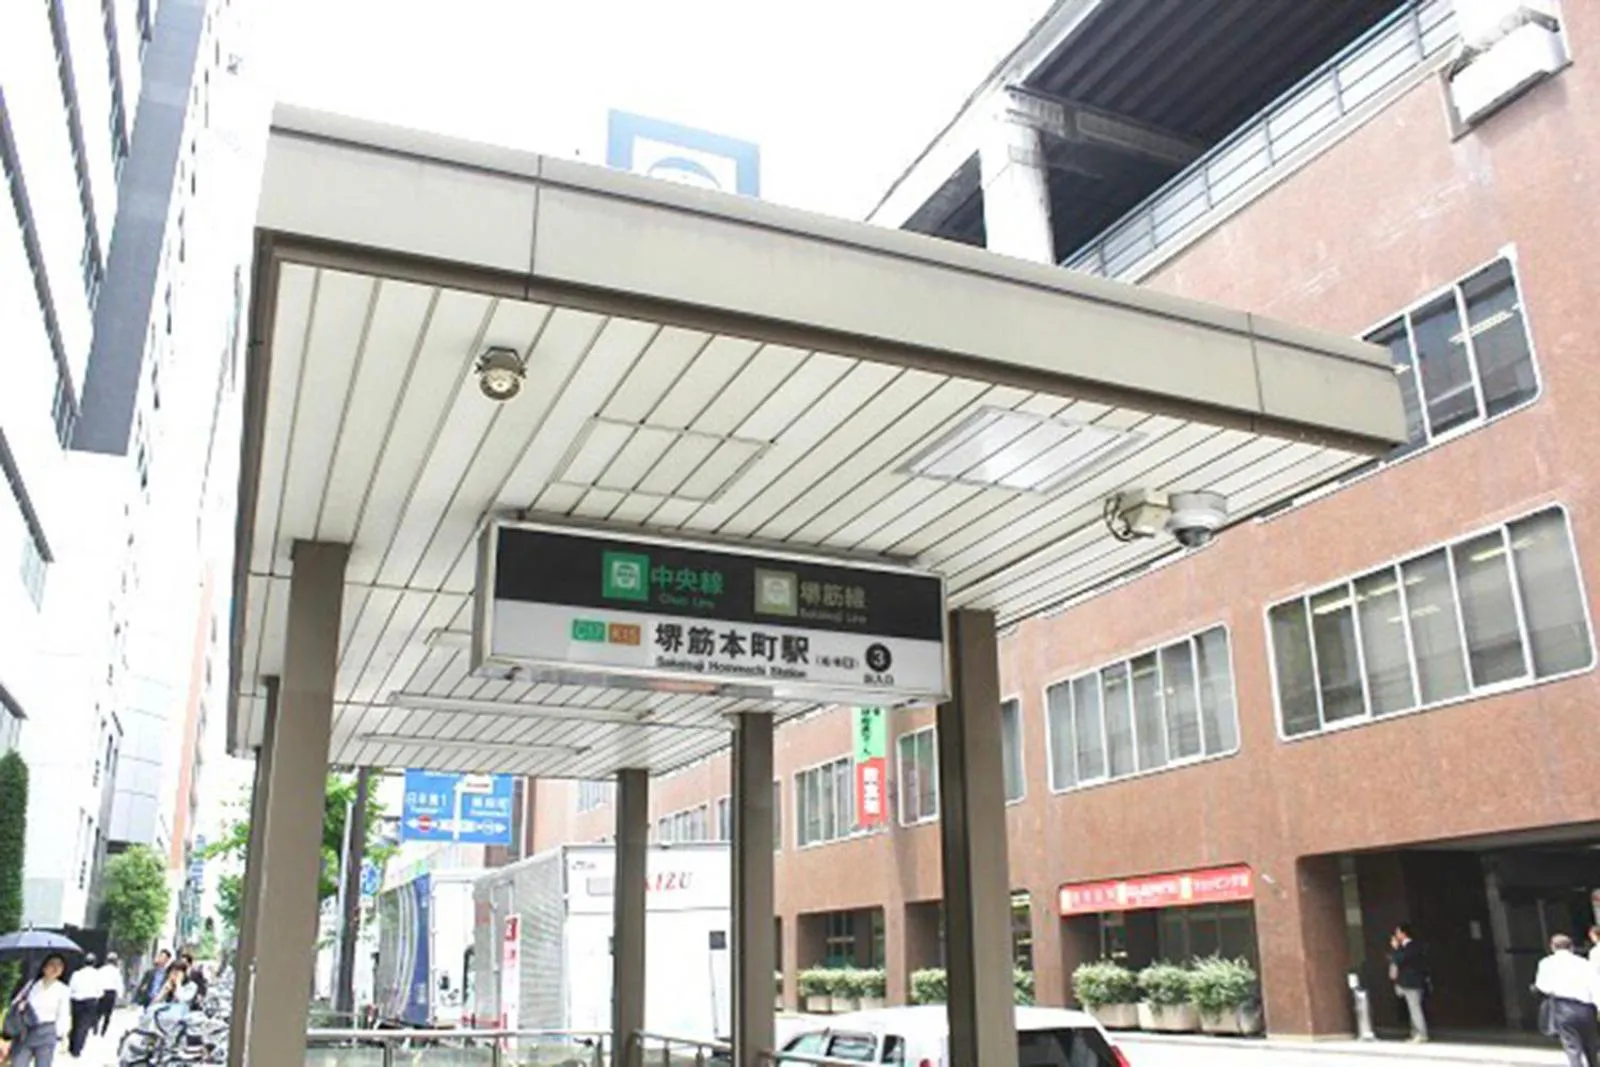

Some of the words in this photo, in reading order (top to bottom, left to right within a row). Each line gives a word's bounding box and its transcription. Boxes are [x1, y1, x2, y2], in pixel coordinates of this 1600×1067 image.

[652, 565, 722, 595] 中央線
[800, 581, 865, 609] 堺筋線
[655, 623, 809, 665] 堺筋本町駅
